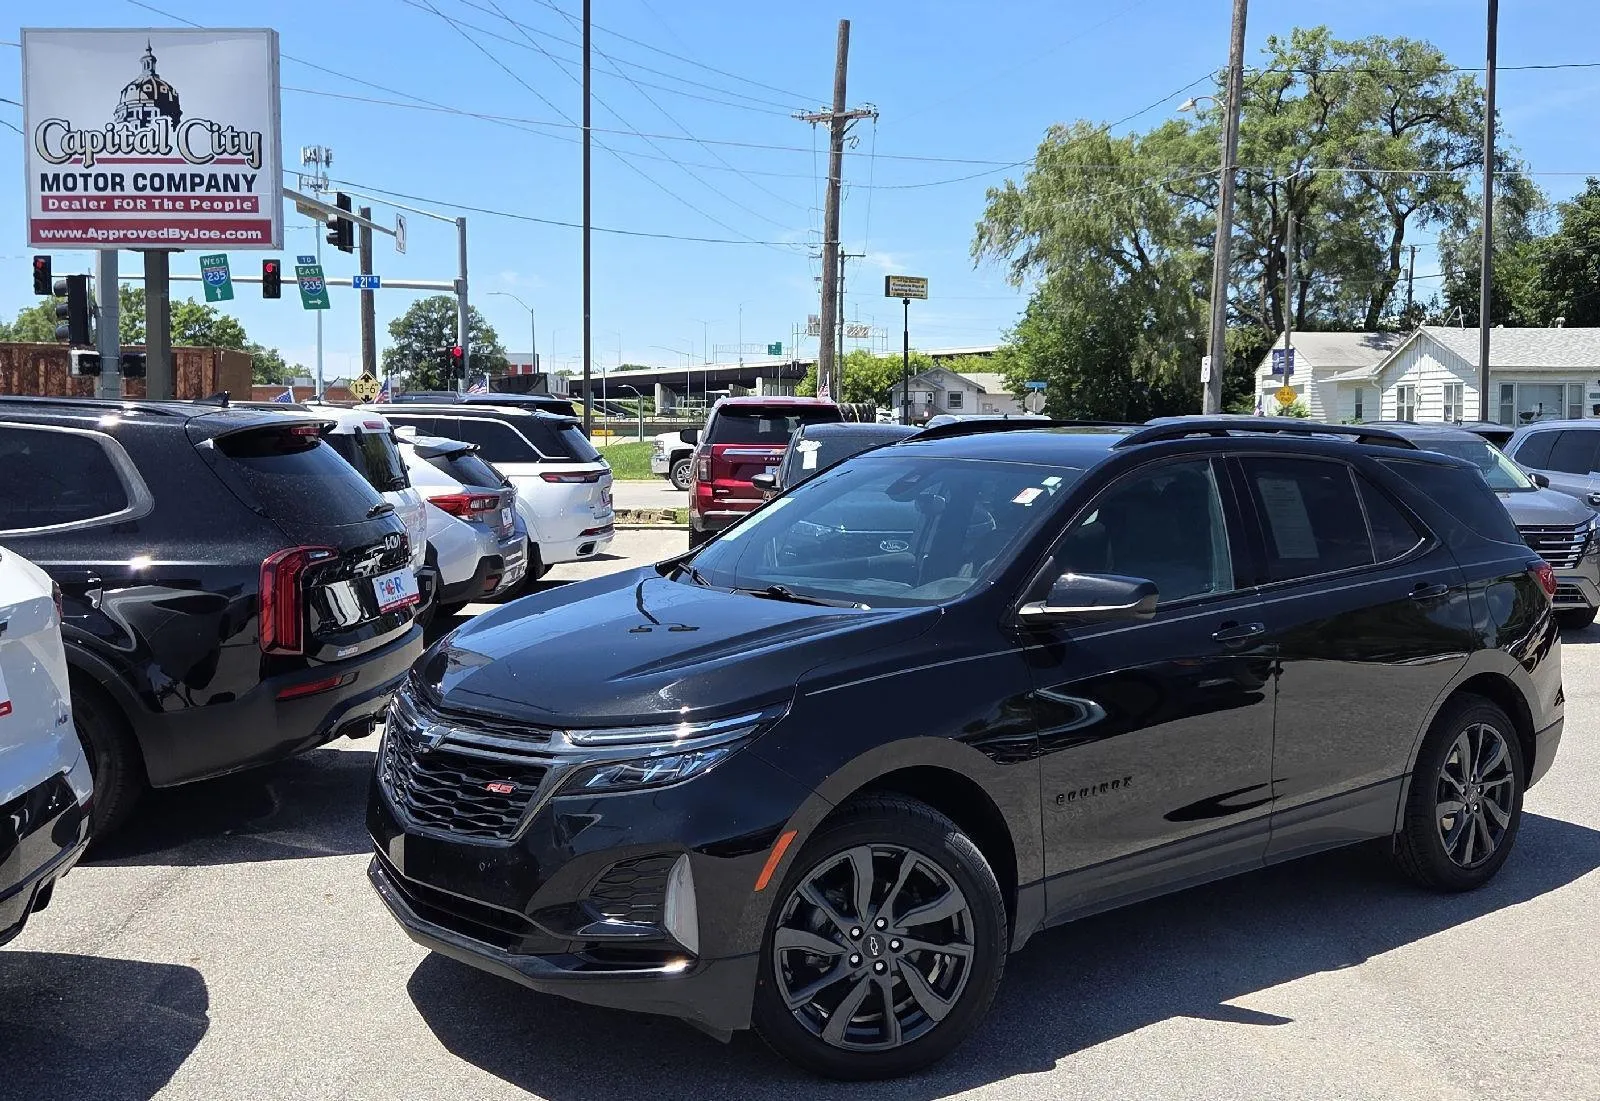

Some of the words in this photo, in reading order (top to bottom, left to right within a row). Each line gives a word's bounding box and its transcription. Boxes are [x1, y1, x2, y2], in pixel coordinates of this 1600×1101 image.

[35, 118, 173, 169] Capital
[177, 118, 262, 169] City
[41, 173, 125, 192] MOTOR
[133, 173, 257, 192] COMPANY
[48, 198, 107, 210] Dealer
[114, 199, 147, 210] FOR
[152, 198, 184, 210] The
[190, 199, 253, 212] People
[40, 228, 263, 241] www.ApprovedByJoe.com
[203, 257, 225, 266] WEST
[207, 271, 227, 282] 235
[298, 267, 320, 275] EAST
[303, 280, 322, 290] 235
[379, 576, 405, 599] FOR
[486, 783, 514, 794] RS
